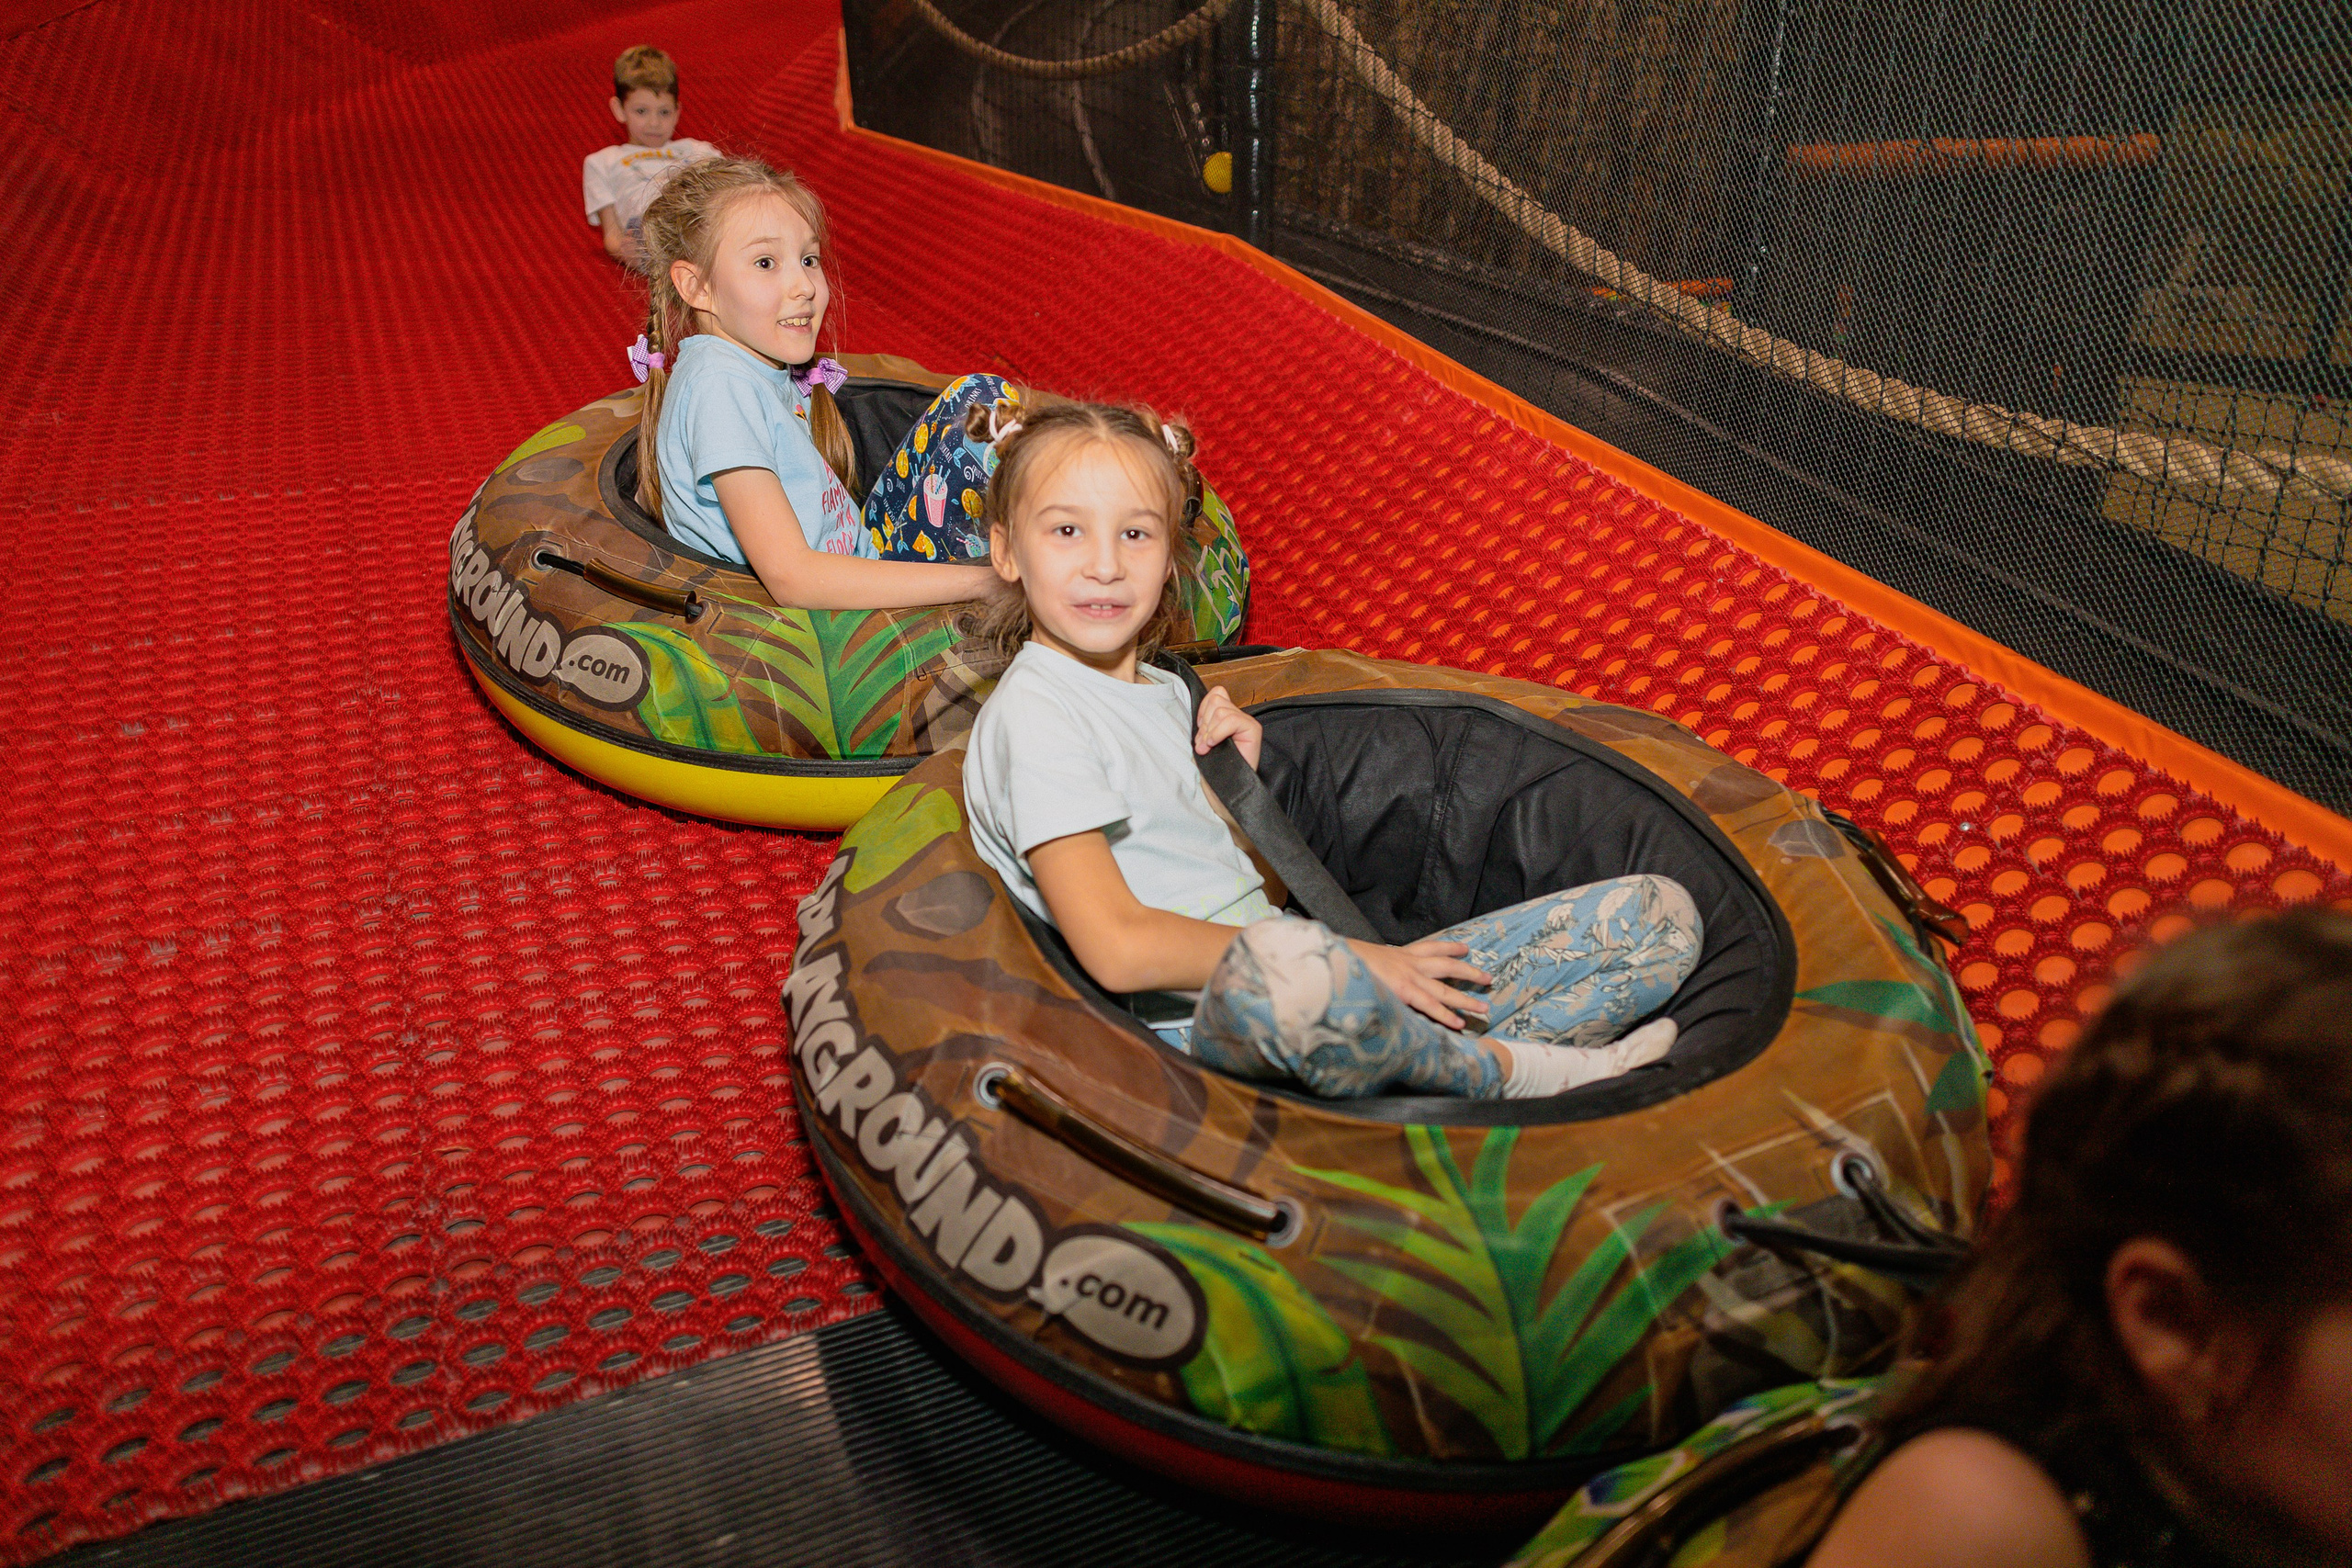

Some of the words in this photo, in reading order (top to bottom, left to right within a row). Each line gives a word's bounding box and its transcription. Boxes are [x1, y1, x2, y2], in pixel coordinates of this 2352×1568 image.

[826, 530, 855, 556] FLOCK
[569, 654, 630, 683] .com
[1059, 1268, 1171, 1331] .com
